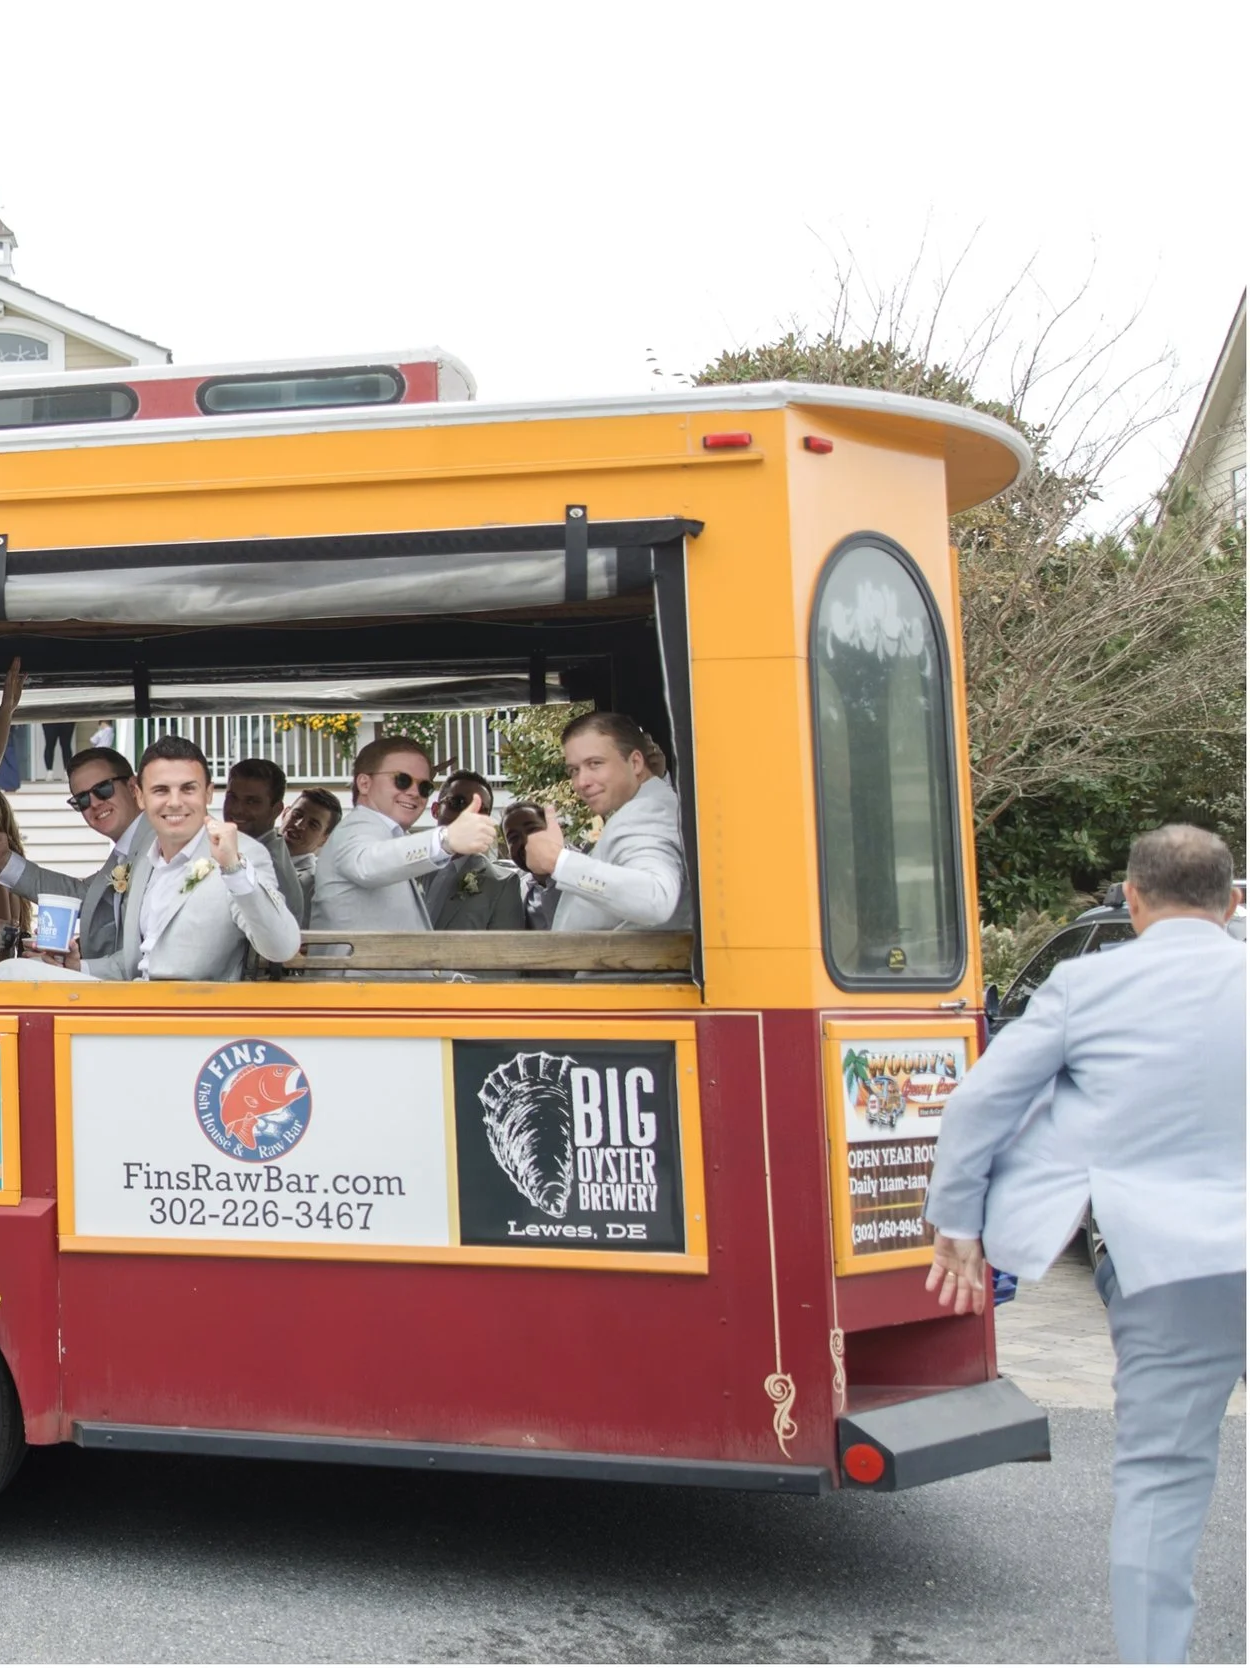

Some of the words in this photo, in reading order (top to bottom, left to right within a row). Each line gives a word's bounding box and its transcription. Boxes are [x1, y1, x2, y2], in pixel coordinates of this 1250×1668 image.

[207, 1043, 267, 1080] FINS
[865, 1050, 957, 1080] WOODY'S
[197, 1081, 212, 1111] Fish
[570, 1066, 657, 1148] BIG
[200, 1112, 232, 1150] House
[282, 1119, 304, 1144] Bar
[232, 1142, 245, 1157] &
[257, 1140, 286, 1159] Raw
[847, 1148, 880, 1169] OPEN
[881, 1146, 913, 1167] YEAR
[913, 1144, 937, 1163] ROU
[122, 1162, 406, 1196] FinsRawBar.com
[577, 1147, 657, 1185] OYSTER
[578, 1183, 659, 1212] BREWERY
[849, 1174, 878, 1198] Daily
[879, 1174, 928, 1193] 11am-1am
[149, 1196, 374, 1231] 302-226-3467
[506, 1220, 599, 1240] Lewes,
[607, 1222, 649, 1240] DE
[851, 1220, 879, 1246] (302)
[878, 1217, 924, 1239] 260-9945
